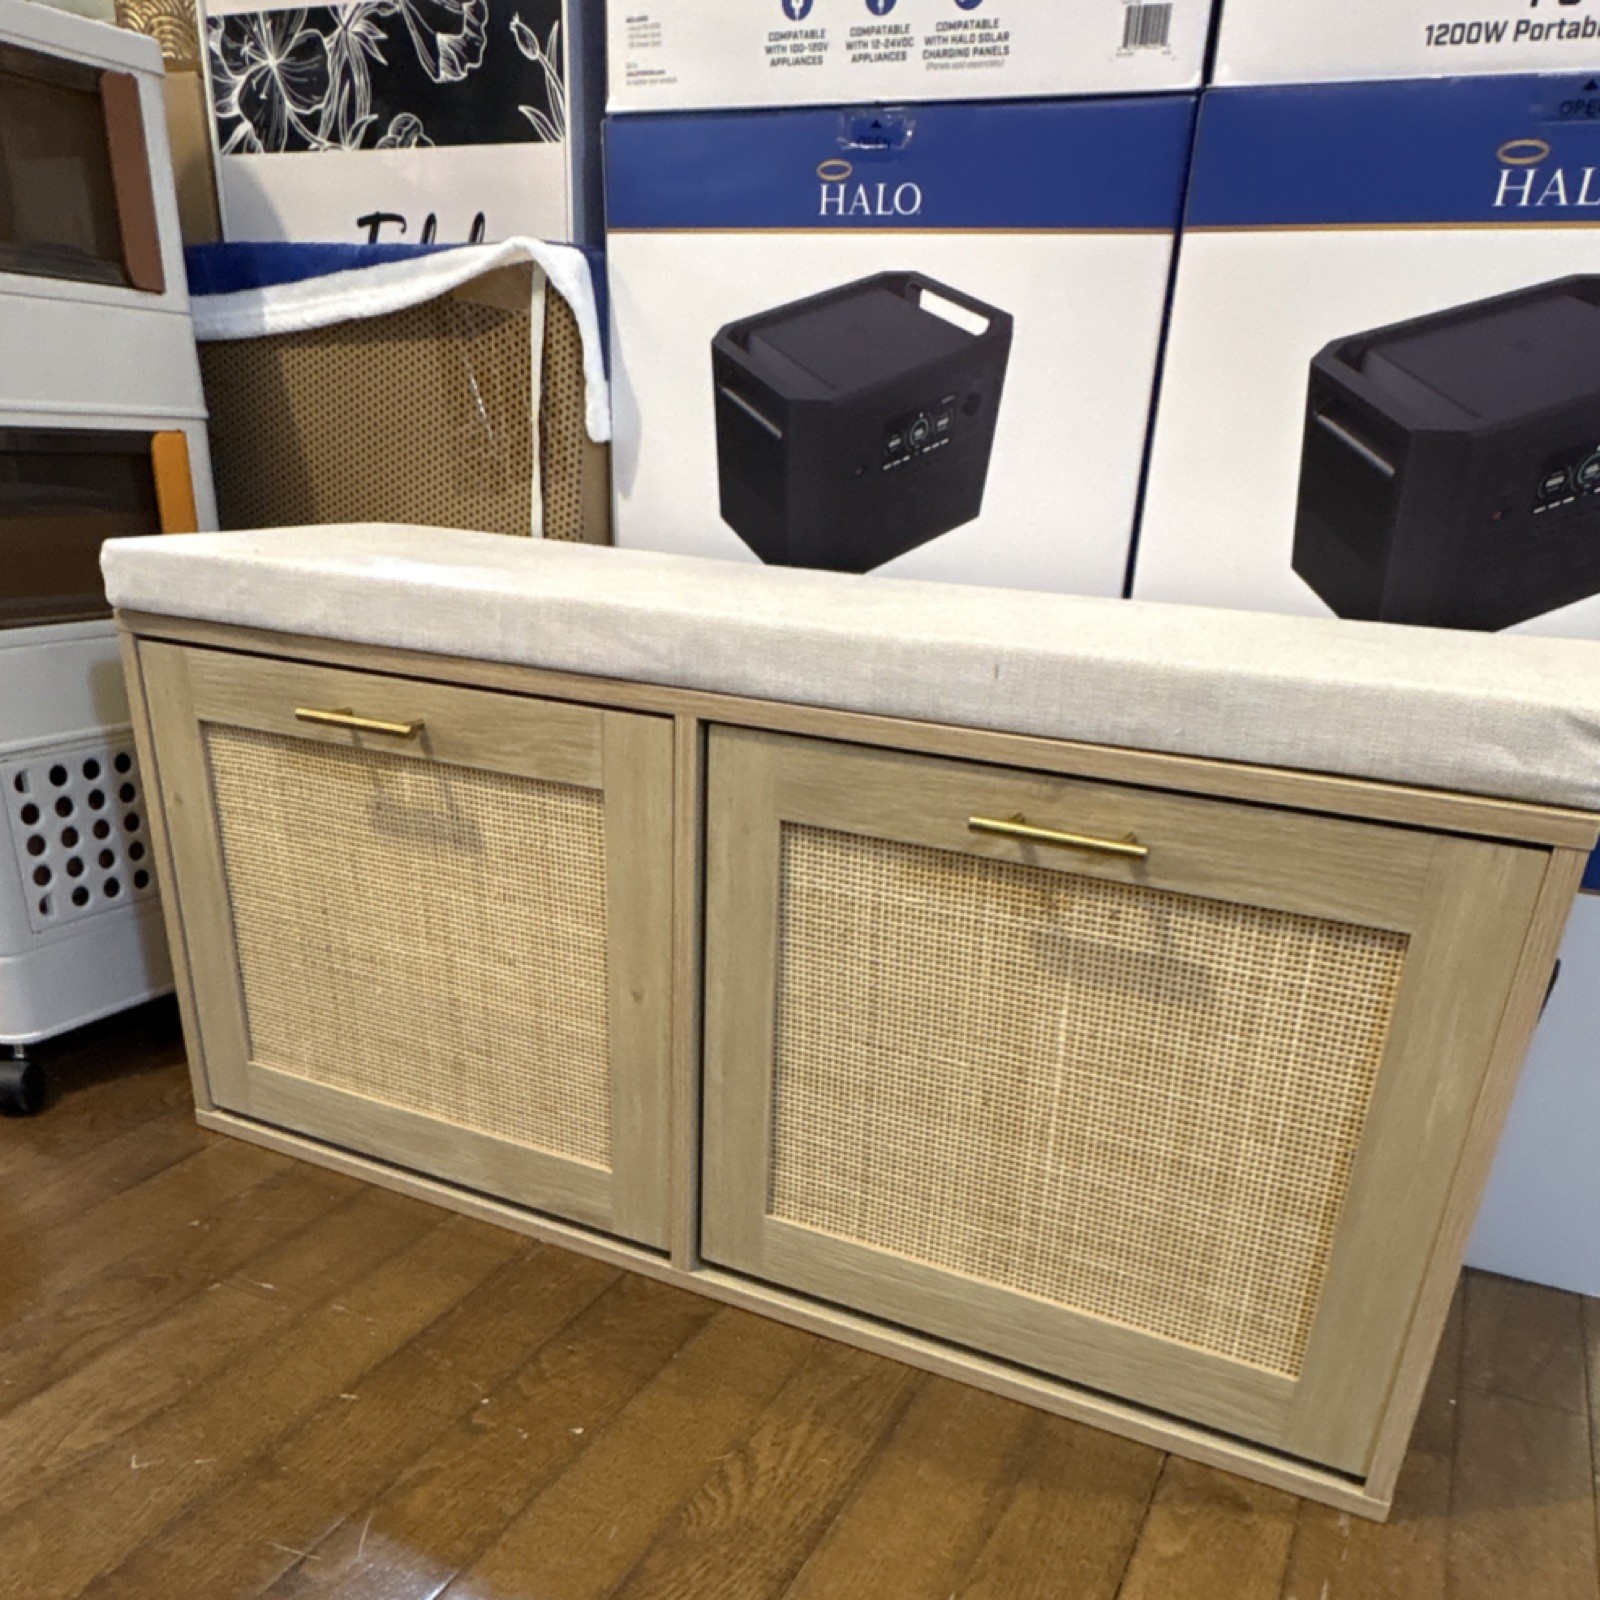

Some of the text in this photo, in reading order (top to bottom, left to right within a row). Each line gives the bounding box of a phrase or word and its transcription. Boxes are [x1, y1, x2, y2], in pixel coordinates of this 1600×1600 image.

[849, 23, 910, 37] COMPATABLE
[935, 17, 999, 32] COMPATABLE
[1425, 15, 1600, 46] 1200W Portab
[768, 27, 827, 42] COMPATABLE
[924, 31, 1010, 46] WITH HALO SOLAR
[765, 43, 787, 54] WITH
[845, 39, 868, 50] WITH
[922, 44, 1010, 59] CHARGING PANELS
[769, 54, 823, 67] APPLIANCES
[851, 50, 907, 63] APPLIANCES
[1560, 98, 1600, 119] OPE
[819, 182, 922, 216] HALO
